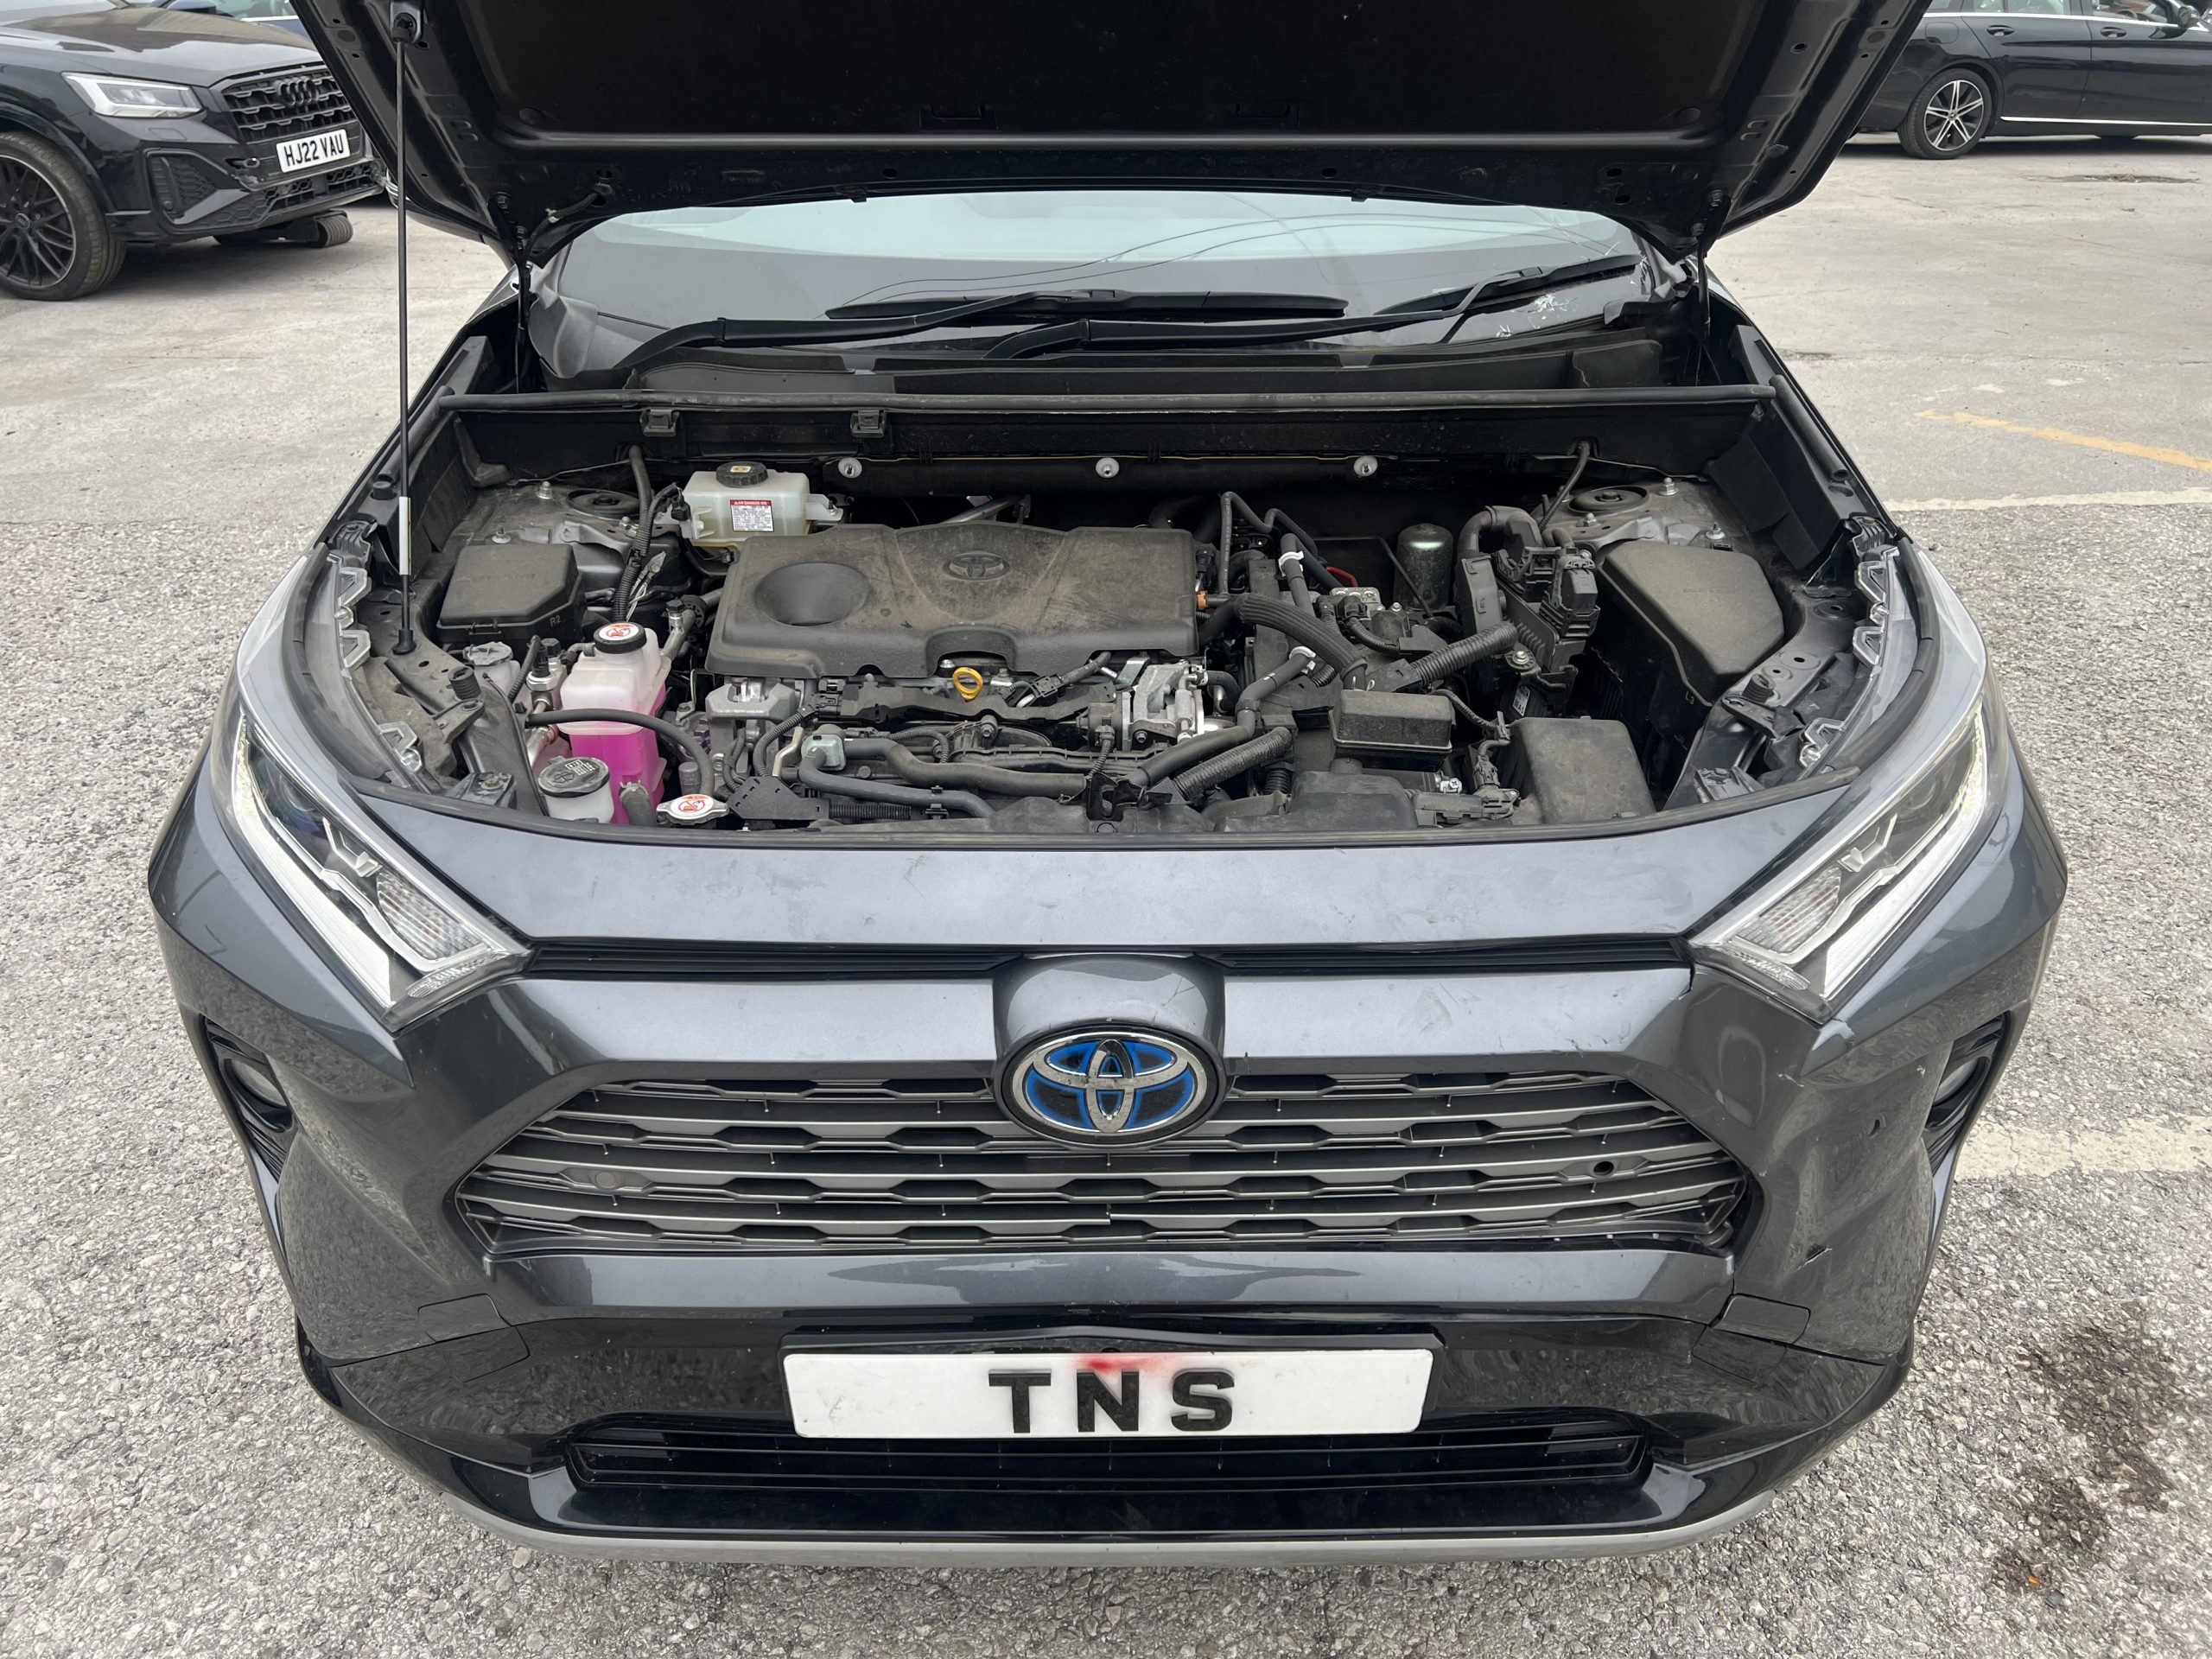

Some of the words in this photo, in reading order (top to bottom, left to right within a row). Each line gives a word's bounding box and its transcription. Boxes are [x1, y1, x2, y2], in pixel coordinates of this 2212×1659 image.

[283, 140, 320, 167] HJ22
[320, 133, 345, 158] VAU
[988, 1369, 1235, 1433] TNS
